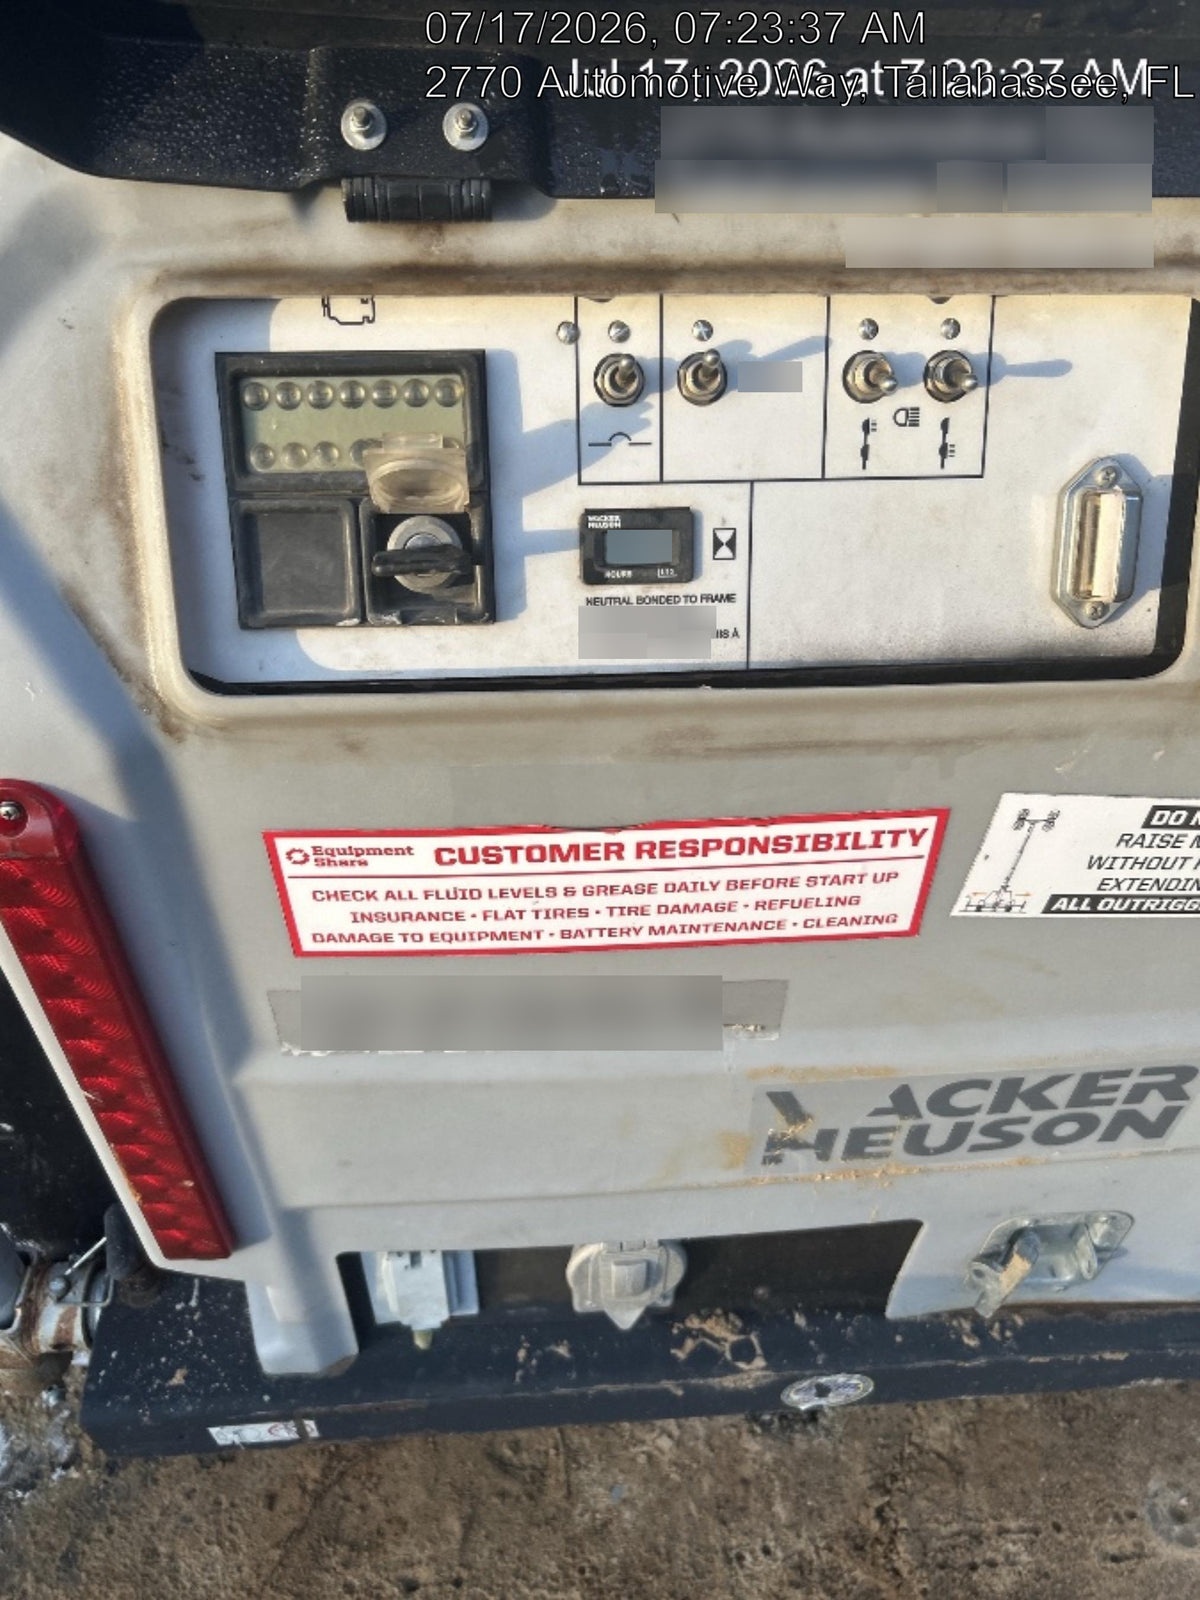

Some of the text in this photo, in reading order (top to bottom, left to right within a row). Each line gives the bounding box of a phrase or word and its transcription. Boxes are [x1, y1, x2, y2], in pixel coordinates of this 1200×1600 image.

[586, 593, 737, 606] NEUTRAL BONDED TO FRAME
[1150, 809, 1189, 826] DO
[434, 828, 929, 866] CUSTOMER RESPONSIBILITY
[1115, 833, 1189, 849] RAISE
[311, 845, 414, 858] Equipment
[314, 857, 369, 867] Share
[1087, 855, 1194, 870] WITHOUT
[311, 871, 898, 902] CHECK ALL FLUID LEVELS & GREASE DAILY BEFORE START UP
[350, 895, 861, 923] INSURANCE FLAT TIRES TIRE DAMAGE REFUELING
[1051, 898, 1091, 911] ALL
[312, 913, 898, 944] DAMAGE TO EQUIPMENT BATTERY MAINTENANCE CLEANING
[762, 1105, 1185, 1166] HEUSON
